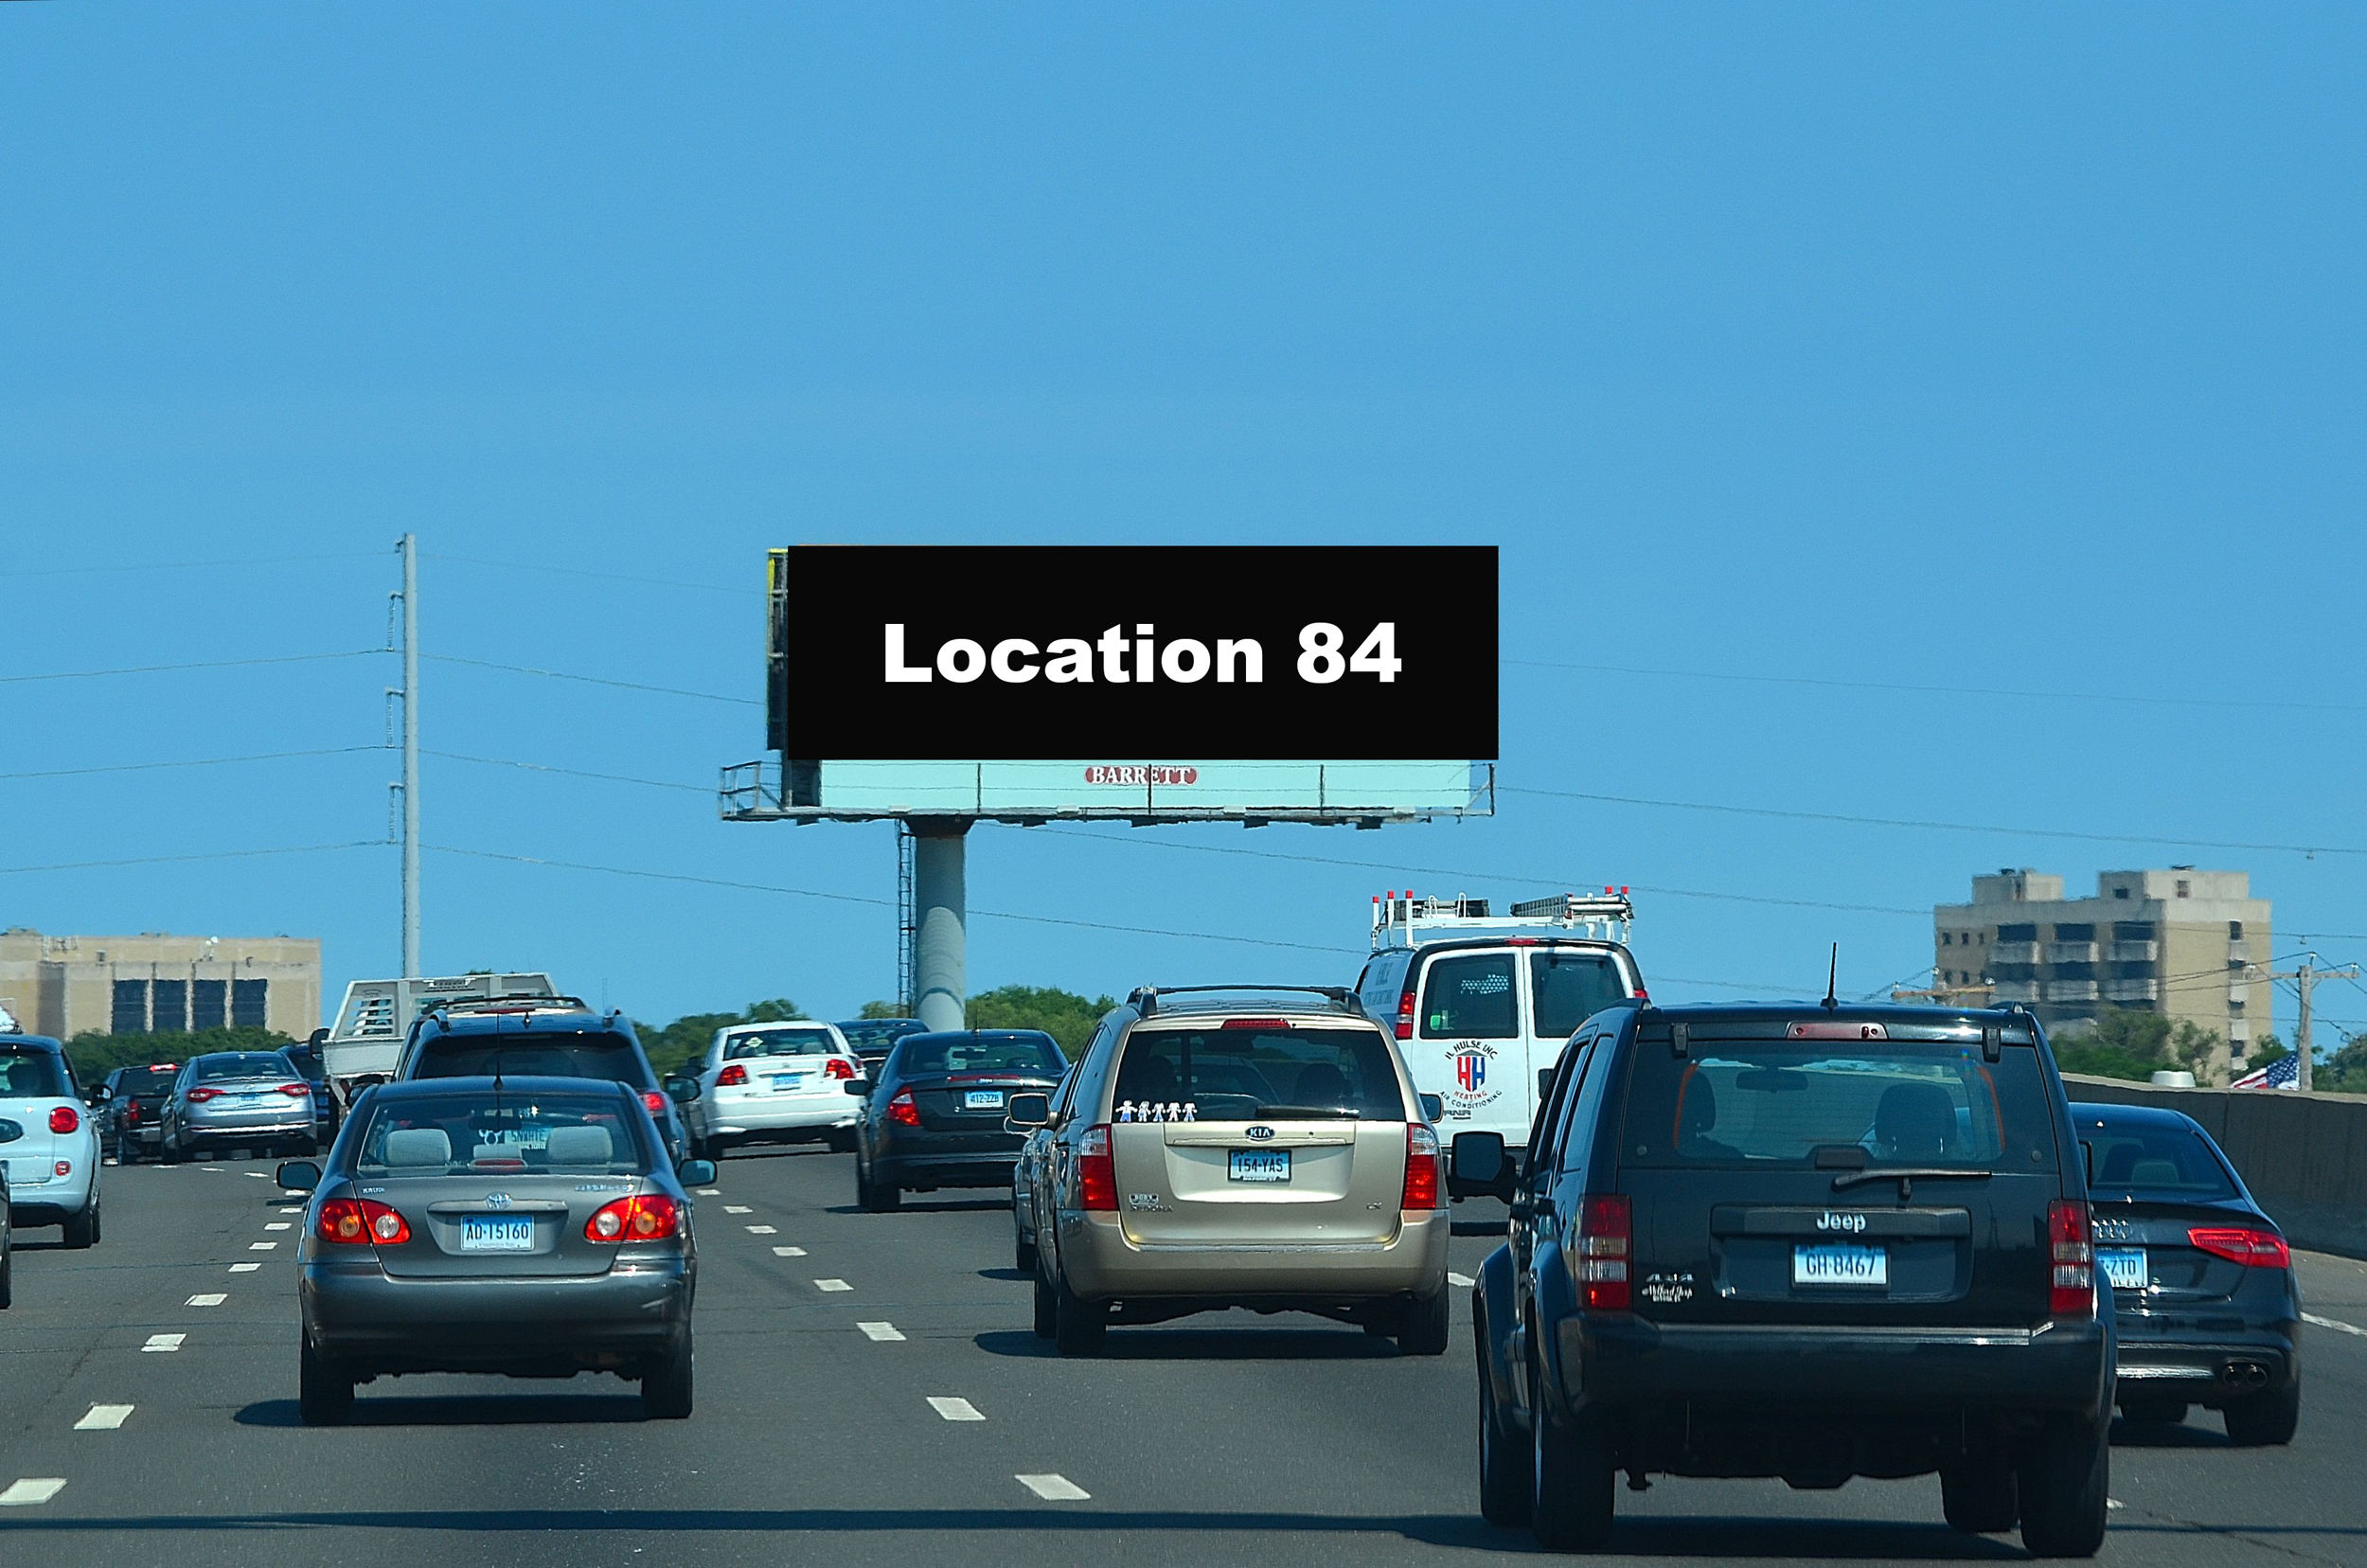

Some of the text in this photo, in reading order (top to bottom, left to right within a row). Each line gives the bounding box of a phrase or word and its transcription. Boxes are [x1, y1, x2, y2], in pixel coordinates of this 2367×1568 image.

[1092, 766, 1191, 784] BARRETT
[1453, 1040, 1482, 1052] HULSE
[1482, 1044, 1498, 1060] INC
[1456, 1056, 1486, 1093] HH
[1439, 1089, 1503, 1109] AIR CONDITIONING
[1453, 1090, 1487, 1100] HEATING
[1250, 1128, 1271, 1136] KIA
[1816, 1211, 1866, 1234] Jeep
